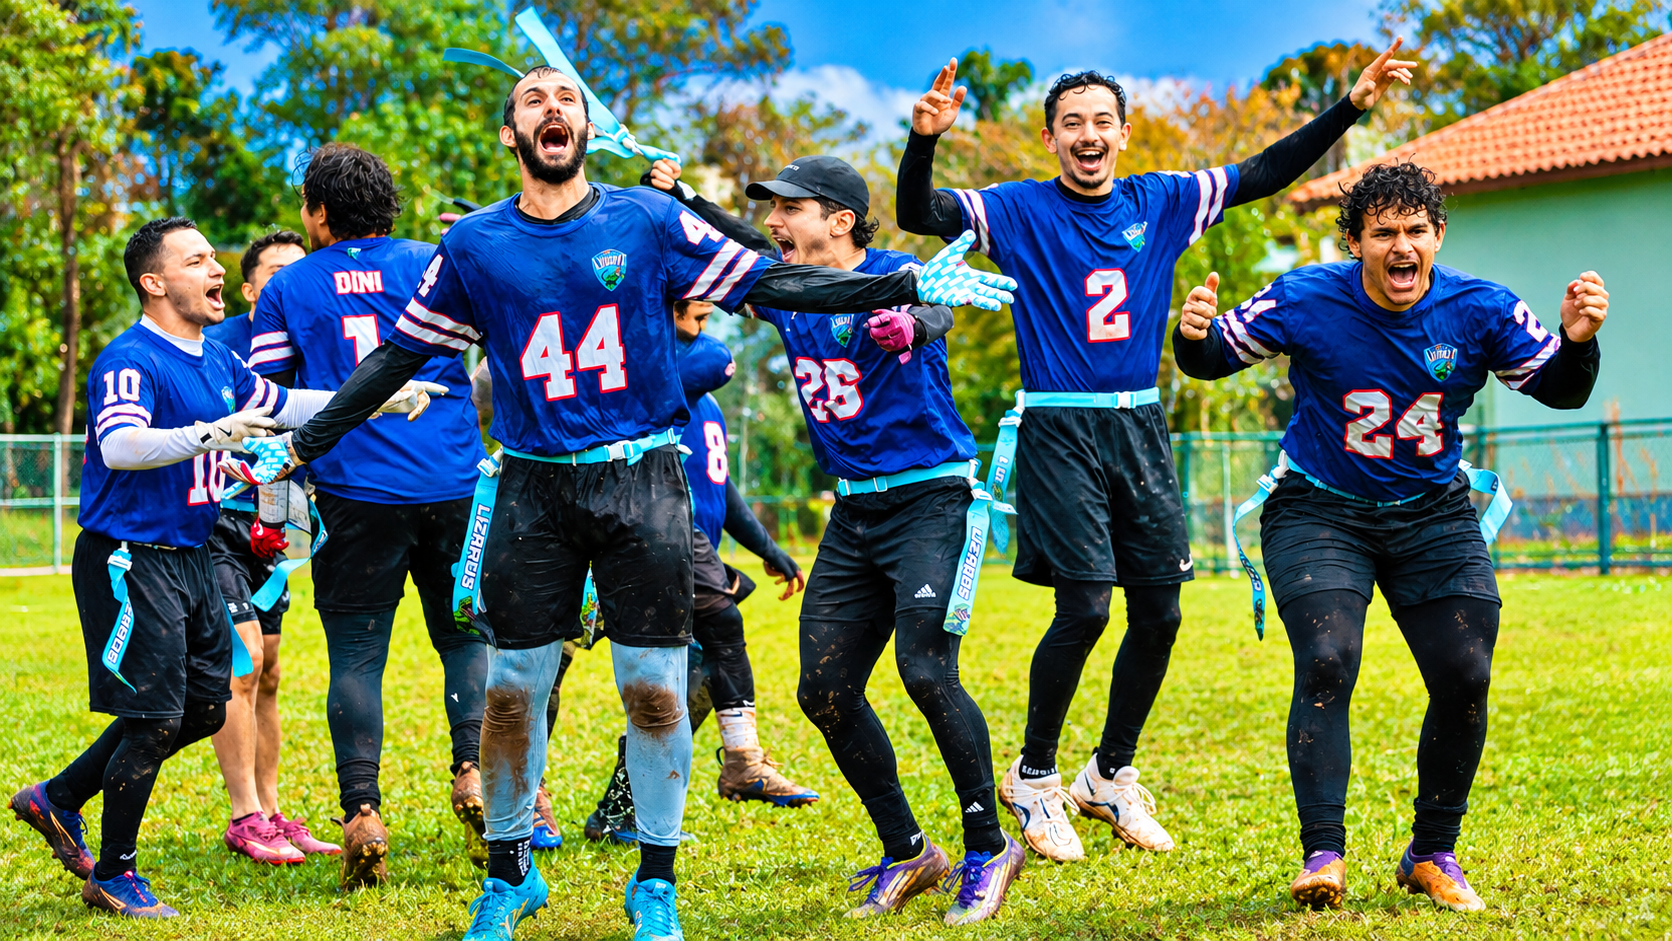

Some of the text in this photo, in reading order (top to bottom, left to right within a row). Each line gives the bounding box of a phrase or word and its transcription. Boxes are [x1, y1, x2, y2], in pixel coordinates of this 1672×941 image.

[333, 269, 384, 295] DINI
[1084, 267, 1131, 343] 2
[103, 367, 141, 406] 10
[520, 303, 628, 401] 44
[793, 356, 864, 423] 26
[1343, 388, 1445, 459] 24
